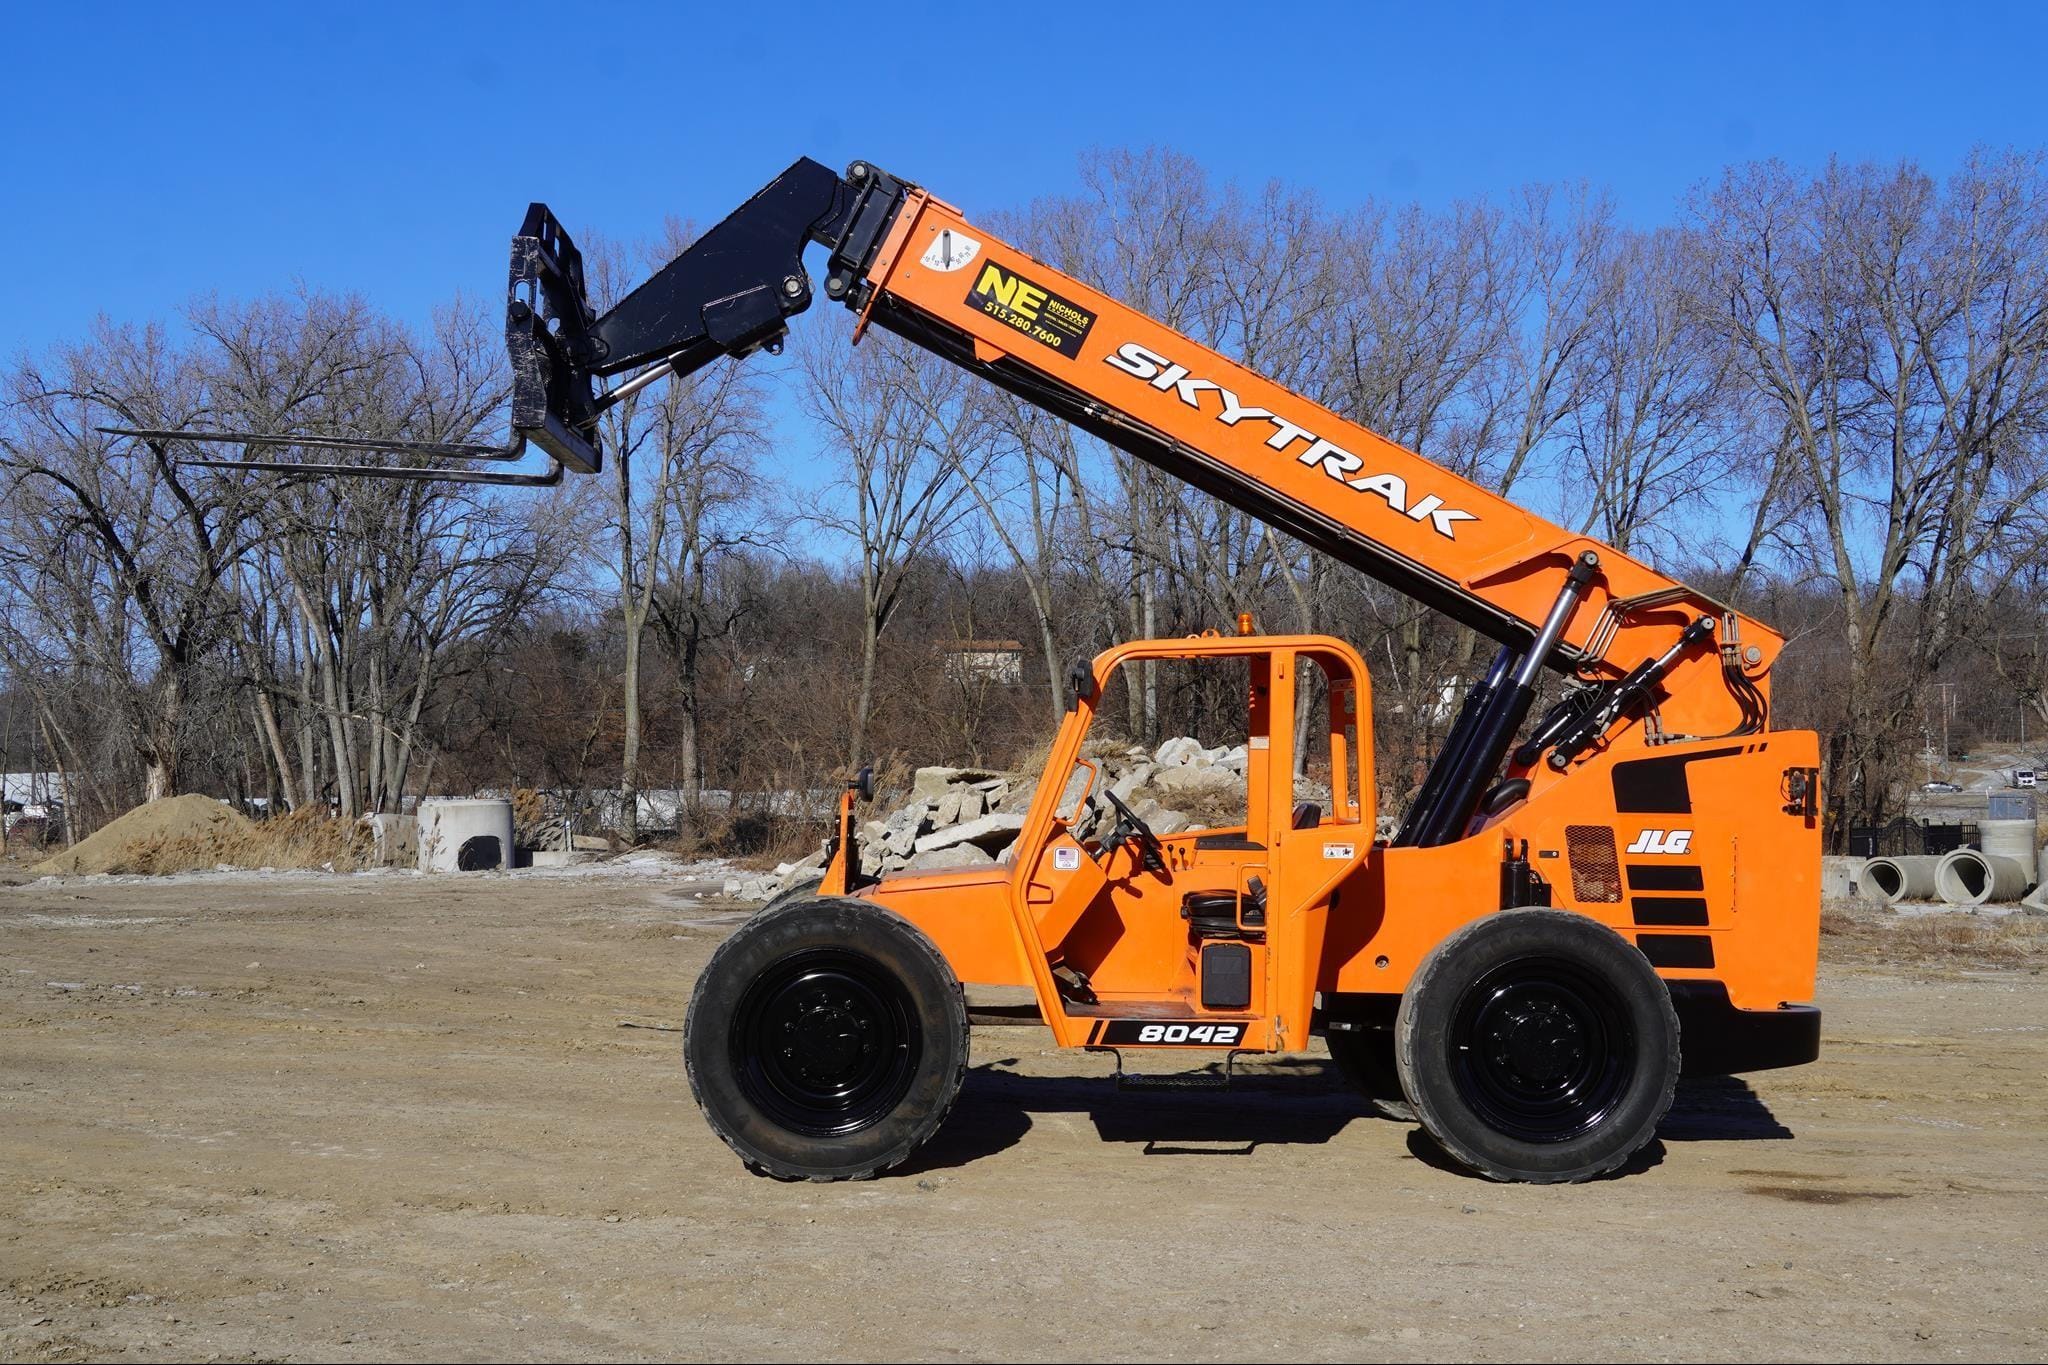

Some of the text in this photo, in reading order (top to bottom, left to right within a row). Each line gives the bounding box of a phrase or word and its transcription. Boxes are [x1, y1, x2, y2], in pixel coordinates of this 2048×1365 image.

[976, 265, 1047, 321] NE
[984, 301, 1062, 347] 515.280.7600
[1049, 299, 1089, 325] NICHOLS
[1103, 342, 1481, 541] SKYTRAK
[1625, 829, 1694, 855] JLG
[1138, 1025, 1239, 1043] 8042
